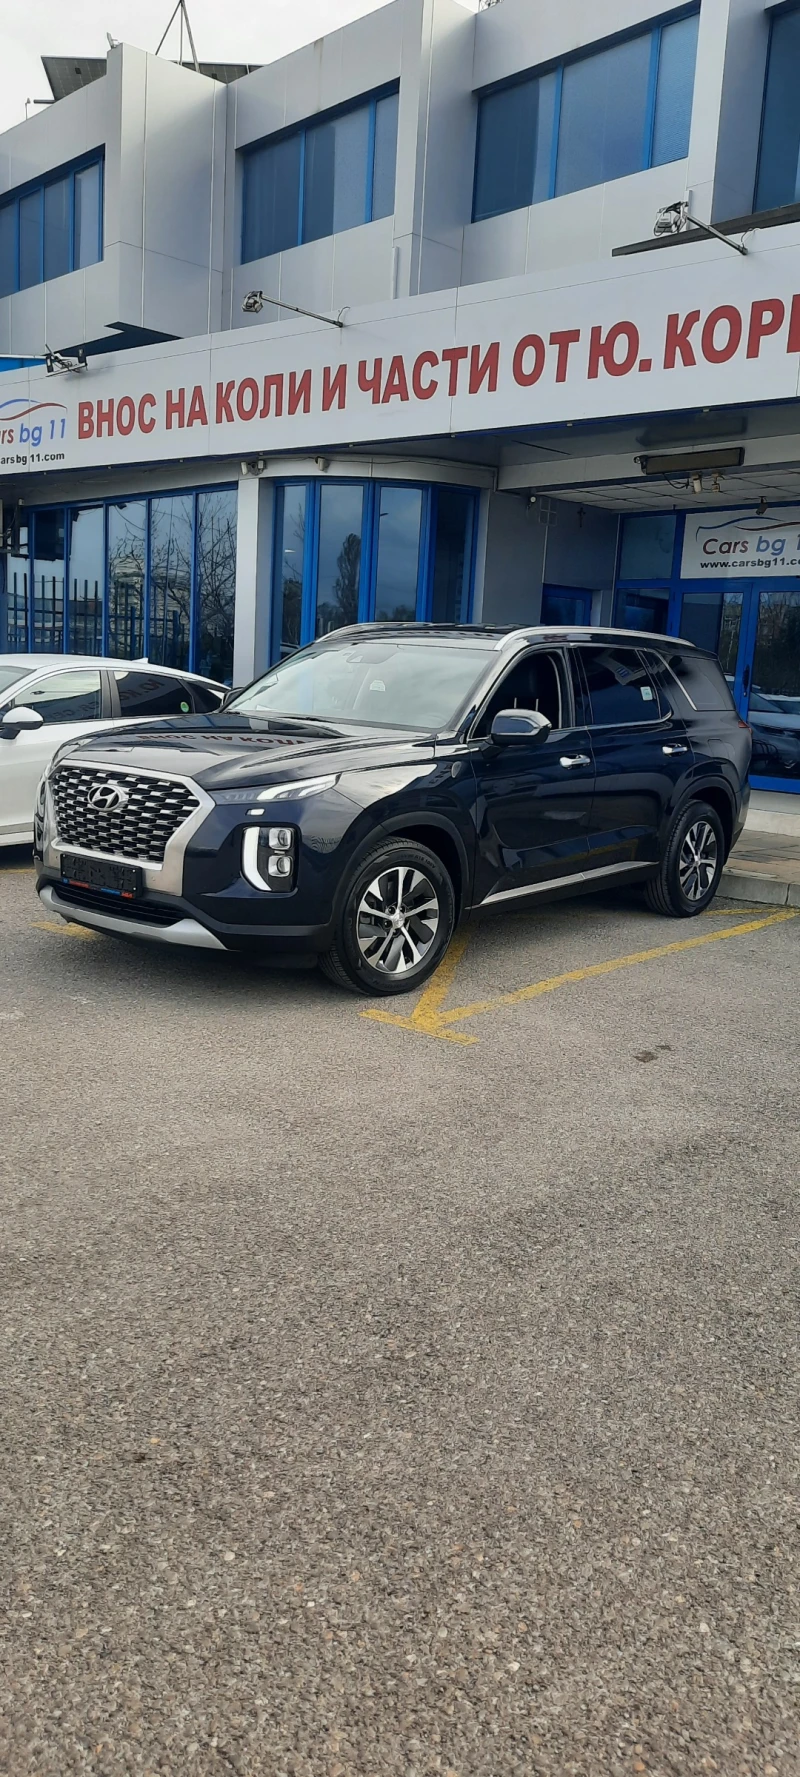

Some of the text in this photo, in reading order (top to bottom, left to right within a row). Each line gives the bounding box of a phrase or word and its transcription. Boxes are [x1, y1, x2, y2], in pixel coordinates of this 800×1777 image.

[77, 393, 157, 440] ВНОС
[165, 385, 208, 430] НА
[215, 369, 312, 425] КОЛИ
[322, 364, 348, 412] И
[357, 341, 500, 405] ЧАСТИ
[512, 329, 580, 387] ОТ
[587, 320, 652, 380] Ю.
[0, 418, 66, 447] rs bg 11
[702, 538, 749, 555] Cars
[756, 535, 786, 556] bg
